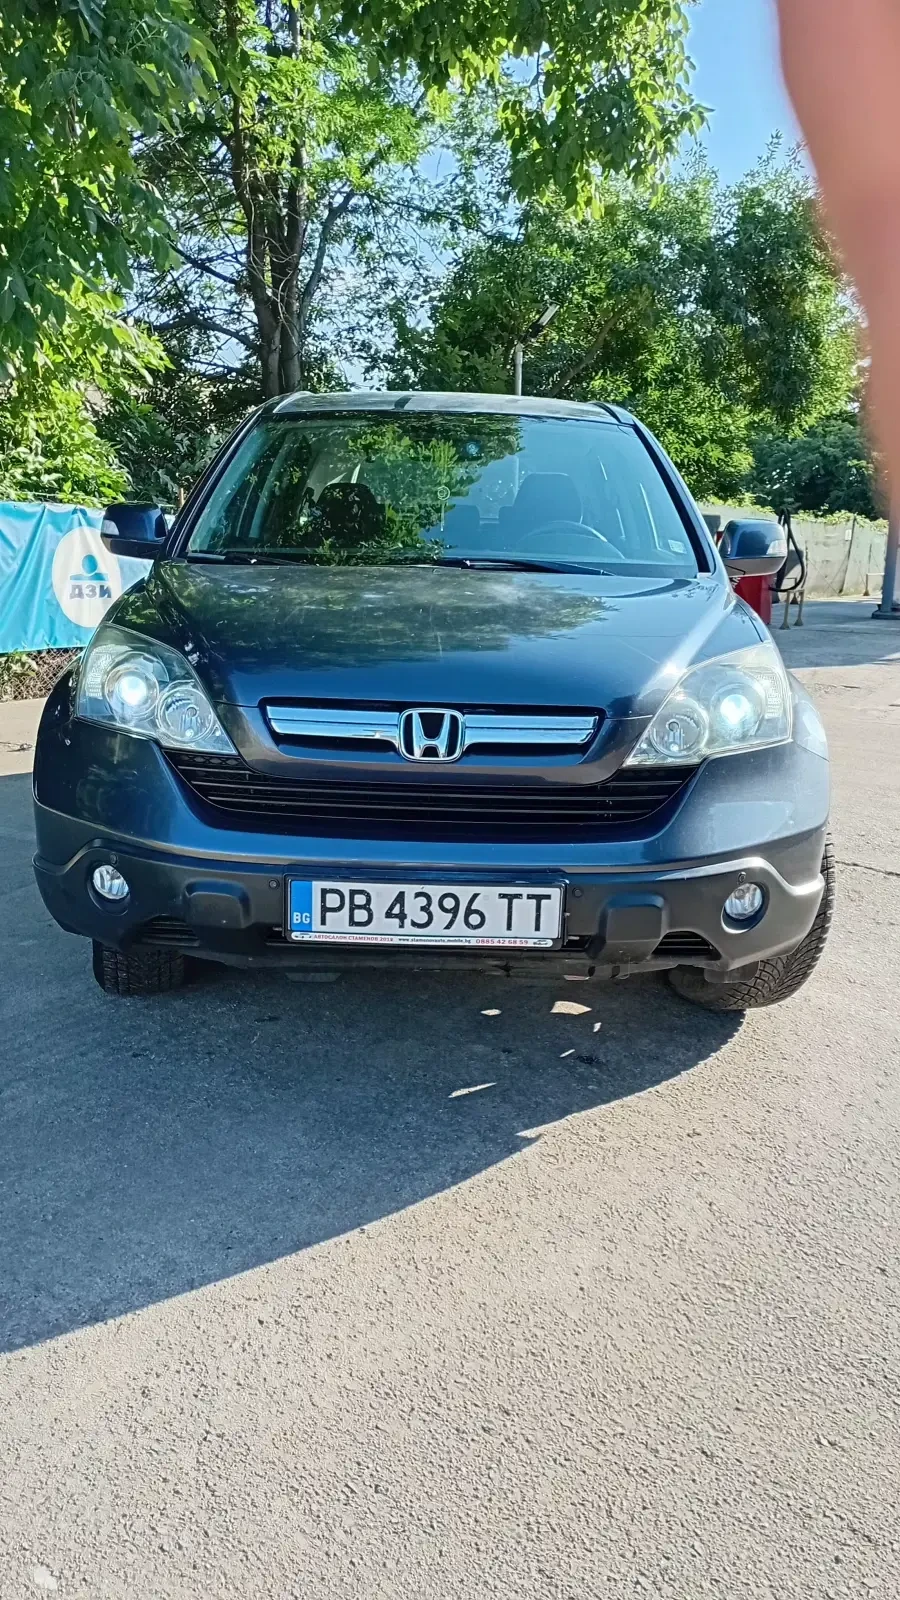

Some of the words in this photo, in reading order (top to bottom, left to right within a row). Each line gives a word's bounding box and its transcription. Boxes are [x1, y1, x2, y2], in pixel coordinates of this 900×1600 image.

[69, 584, 112, 599] ДЗИ
[319, 887, 374, 928] PB
[384, 890, 487, 931] 4396
[497, 892, 552, 932] TT
[293, 912, 311, 924] BG
